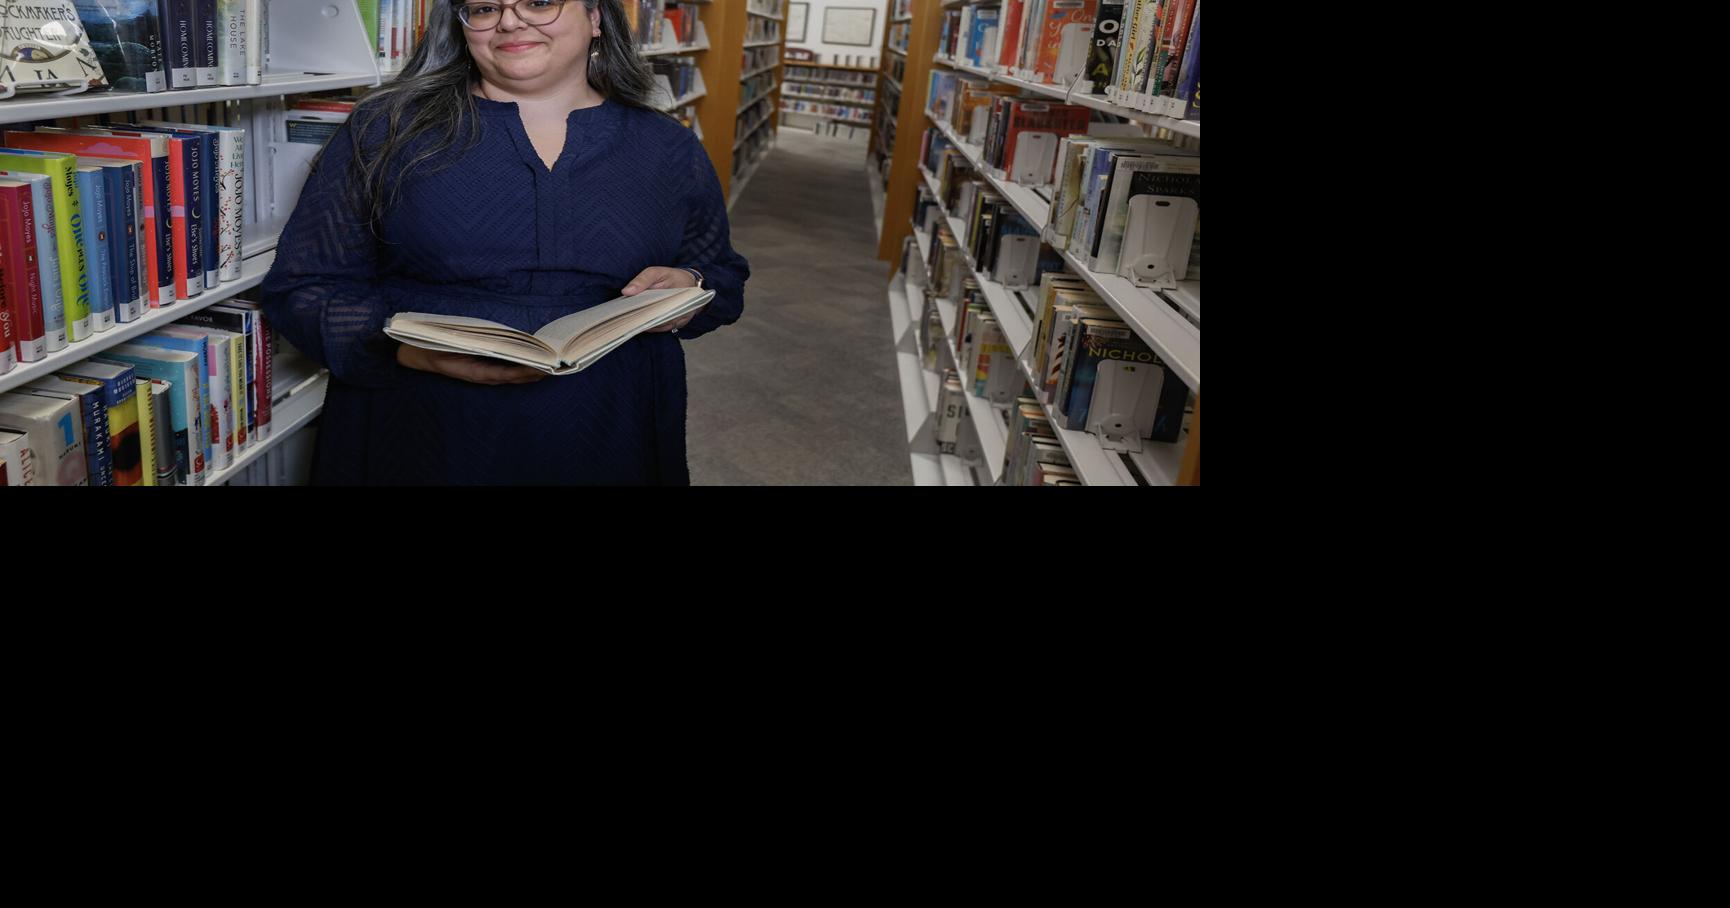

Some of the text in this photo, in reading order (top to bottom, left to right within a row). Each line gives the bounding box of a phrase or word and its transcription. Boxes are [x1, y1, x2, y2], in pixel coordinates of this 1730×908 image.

[230, 15, 238, 49] HOUSE
[64, 166, 74, 197] Moyes
[191, 147, 200, 202] JOJO MOYES
[22, 200, 32, 243] Jojo Moyes
[96, 200, 104, 223] Moyes
[233, 173, 244, 250] JOJO MOYES
[1088, 347, 1162, 365] NICHOL
[57, 410, 75, 447] 1
[92, 401, 106, 461] MURAKAMI
